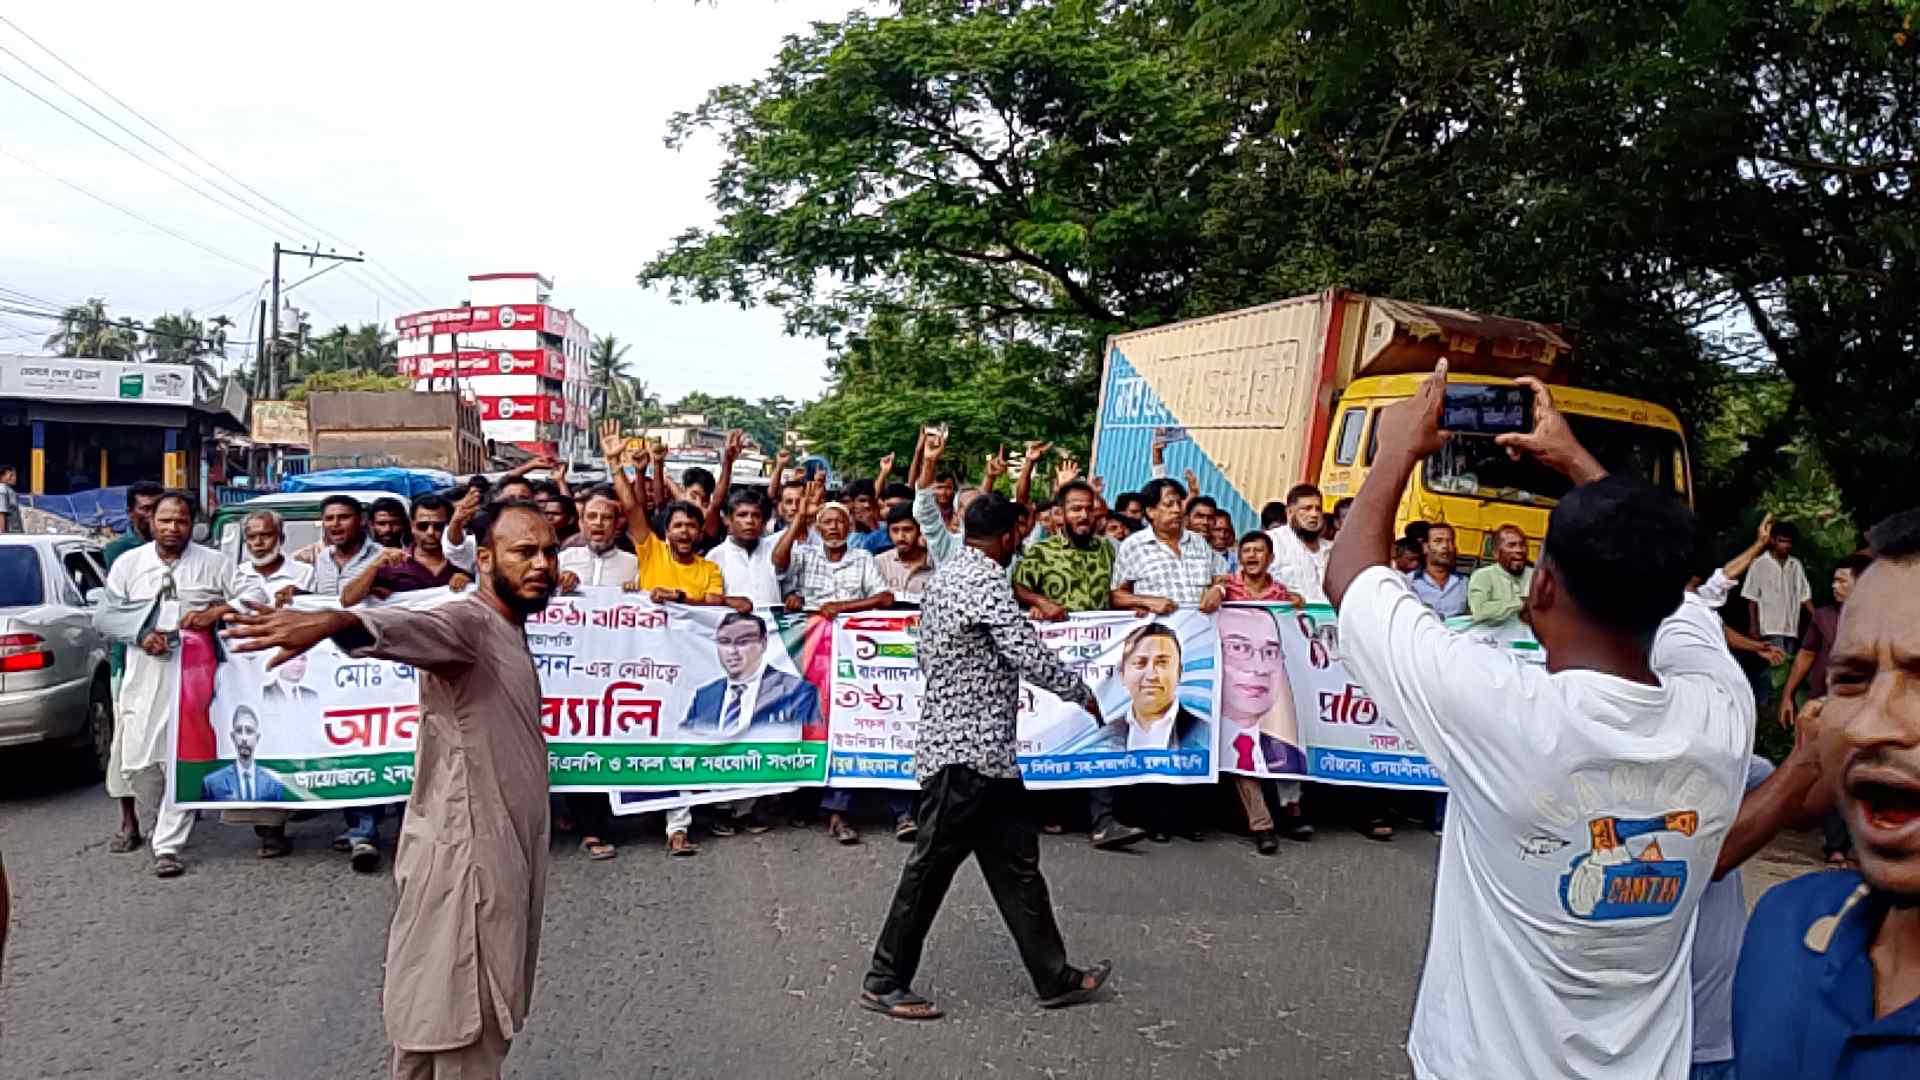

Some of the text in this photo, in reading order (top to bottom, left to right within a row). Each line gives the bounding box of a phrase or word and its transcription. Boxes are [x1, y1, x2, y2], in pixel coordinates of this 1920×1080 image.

[592, 603, 669, 629] বার্ষিকী
[336, 663, 382, 688] মোঃ
[1319, 683, 1380, 725] প্রতি
[324, 705, 420, 747] আন
